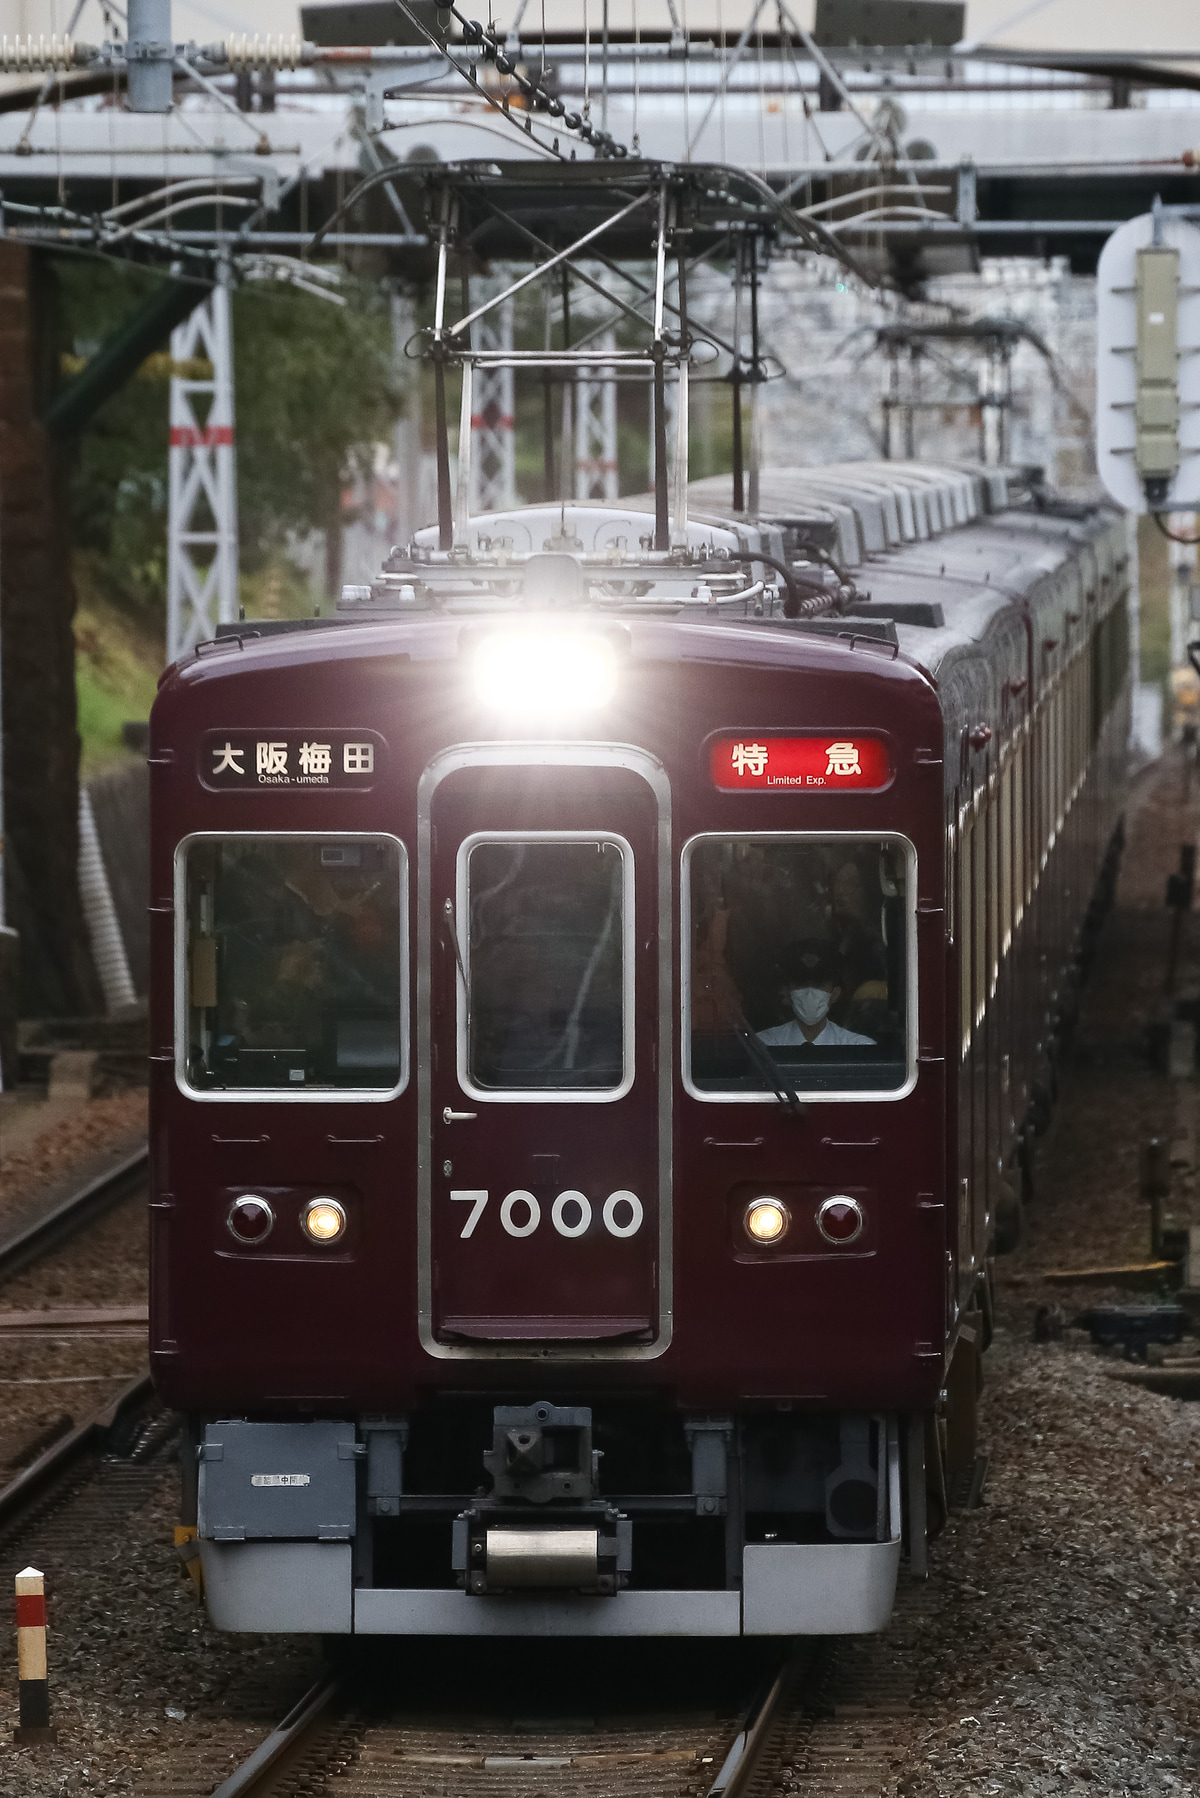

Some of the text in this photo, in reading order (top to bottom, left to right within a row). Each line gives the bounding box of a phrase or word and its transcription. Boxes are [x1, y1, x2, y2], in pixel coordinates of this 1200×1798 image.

[212, 742, 375, 774] 大阪梅田
[731, 742, 862, 776] 特急
[258, 774, 329, 784] Osaka-umeda
[767, 775, 827, 786] Limited Exp.
[450, 1189, 644, 1239] 7000
